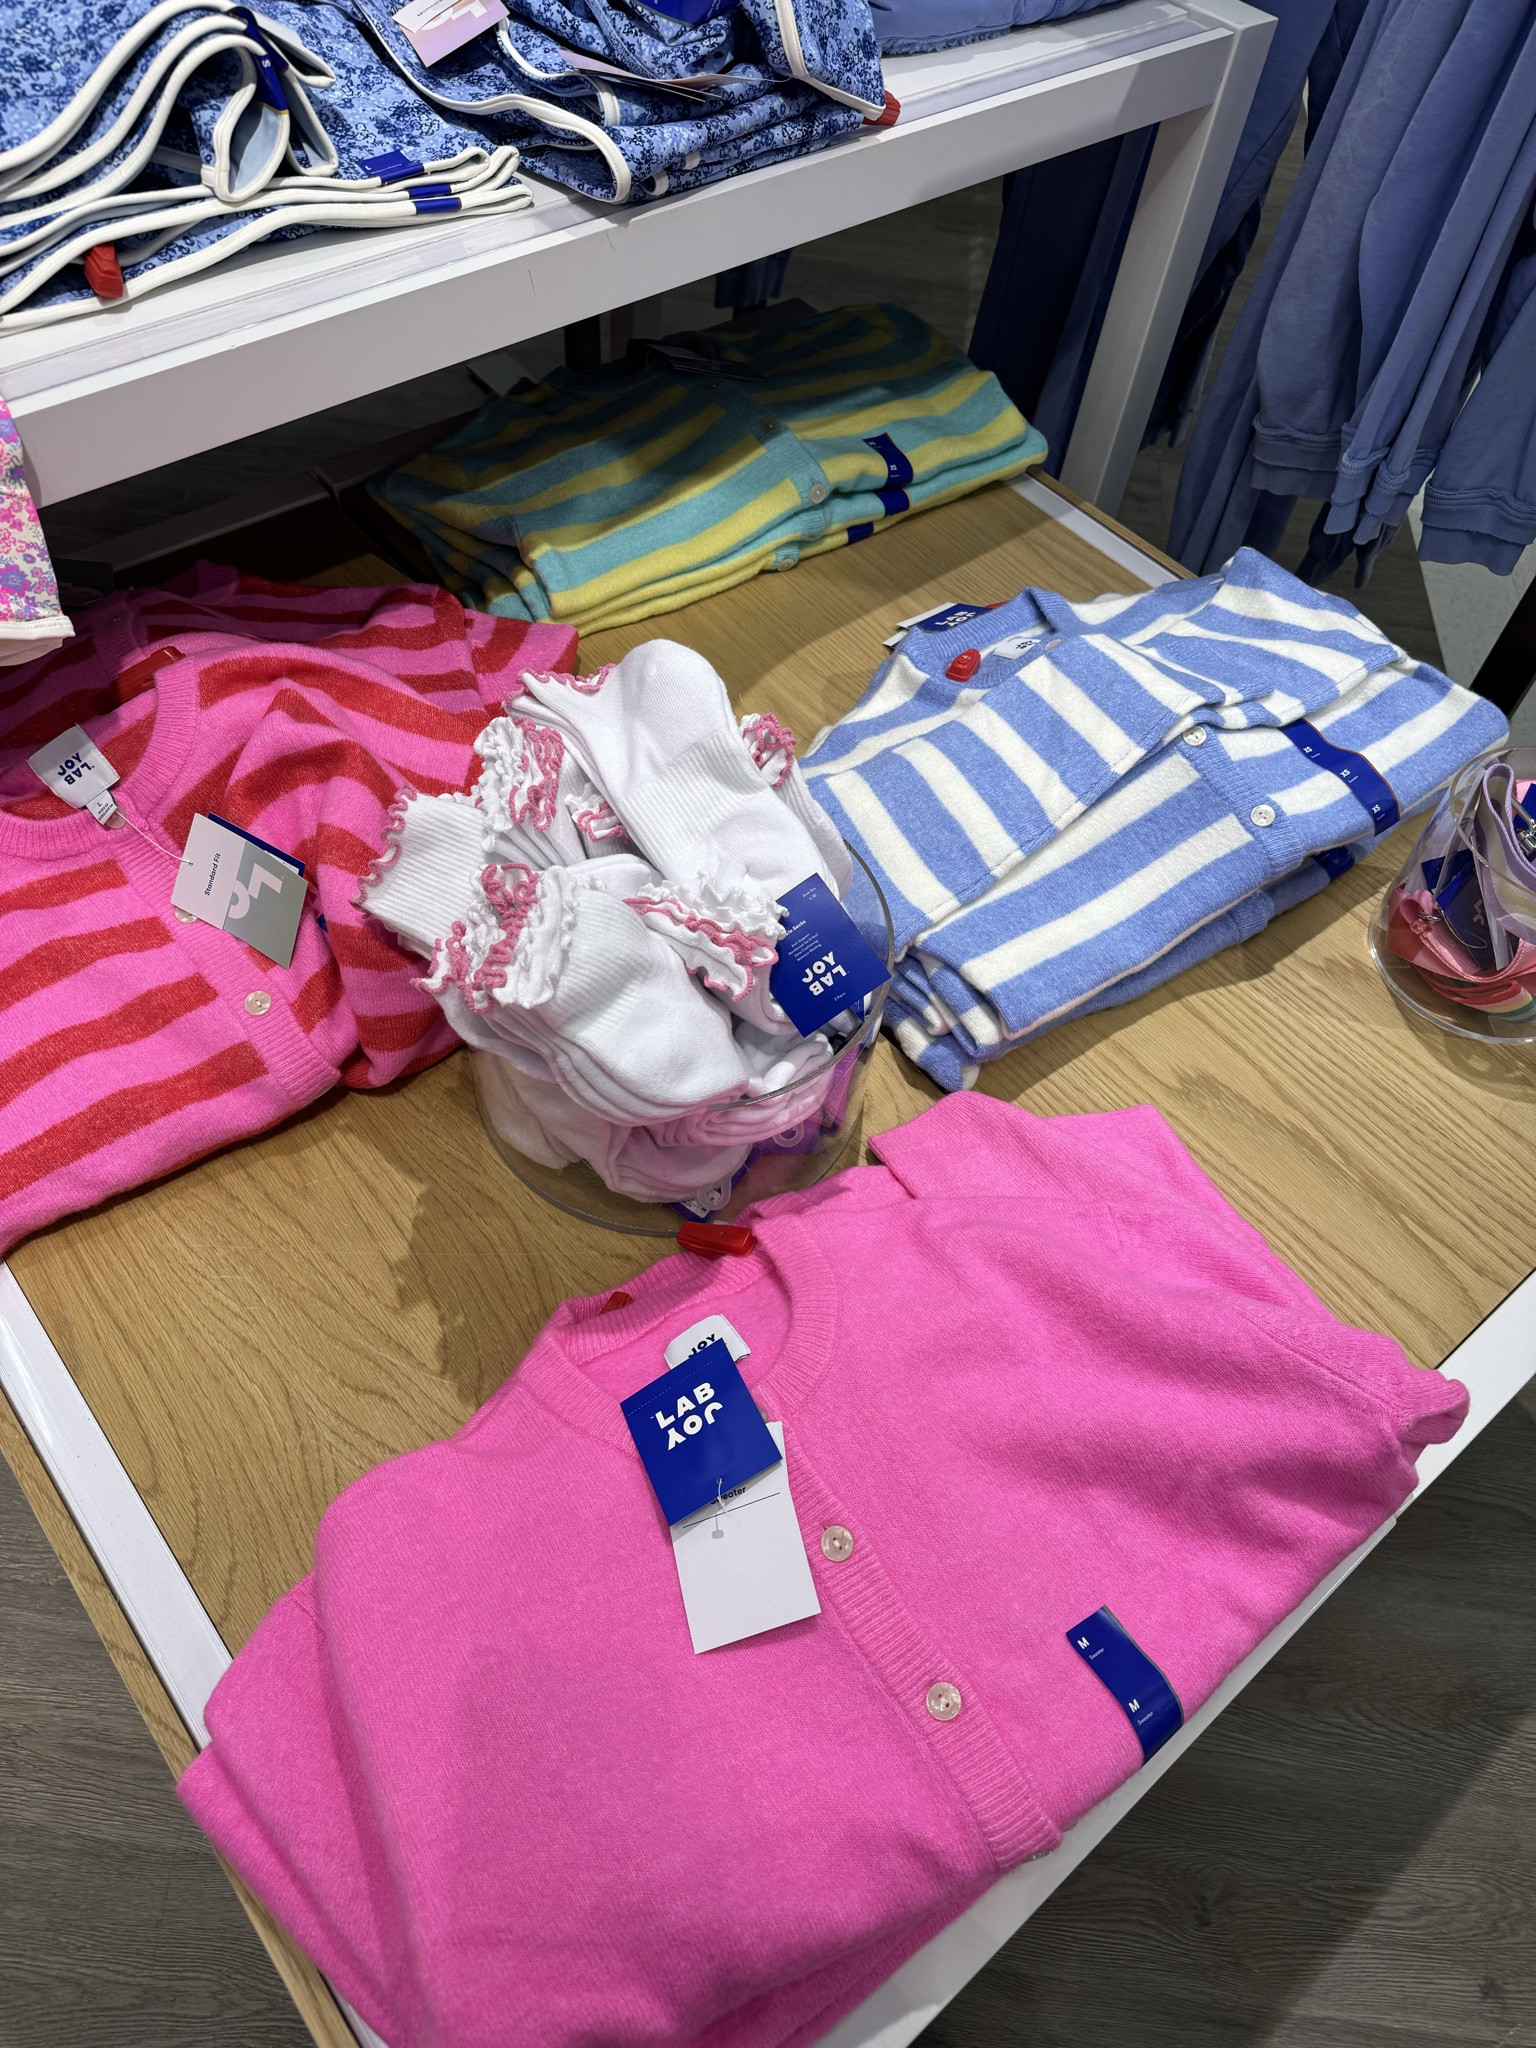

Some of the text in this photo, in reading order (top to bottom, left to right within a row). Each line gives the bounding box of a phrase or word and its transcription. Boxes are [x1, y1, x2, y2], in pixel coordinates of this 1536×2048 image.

[262, 60, 271, 68] S
[57, 752, 82, 776] JOY
[64, 762, 92, 785] LAB
[1340, 769, 1351, 778] XS
[1372, 804, 1381, 814] XS
[204, 852, 221, 896] Standard Fit
[802, 951, 836, 983] JOY
[808, 964, 847, 996] LAB
[688, 1334, 715, 1358] JOY
[655, 1382, 715, 1429] LAB
[667, 1402, 723, 1451] JOY
[1077, 1636, 1090, 1649] M
[1089, 1647, 1105, 1660] Sweater
[1128, 1698, 1140, 1712] M
[1137, 1711, 1154, 1726] Sweater
